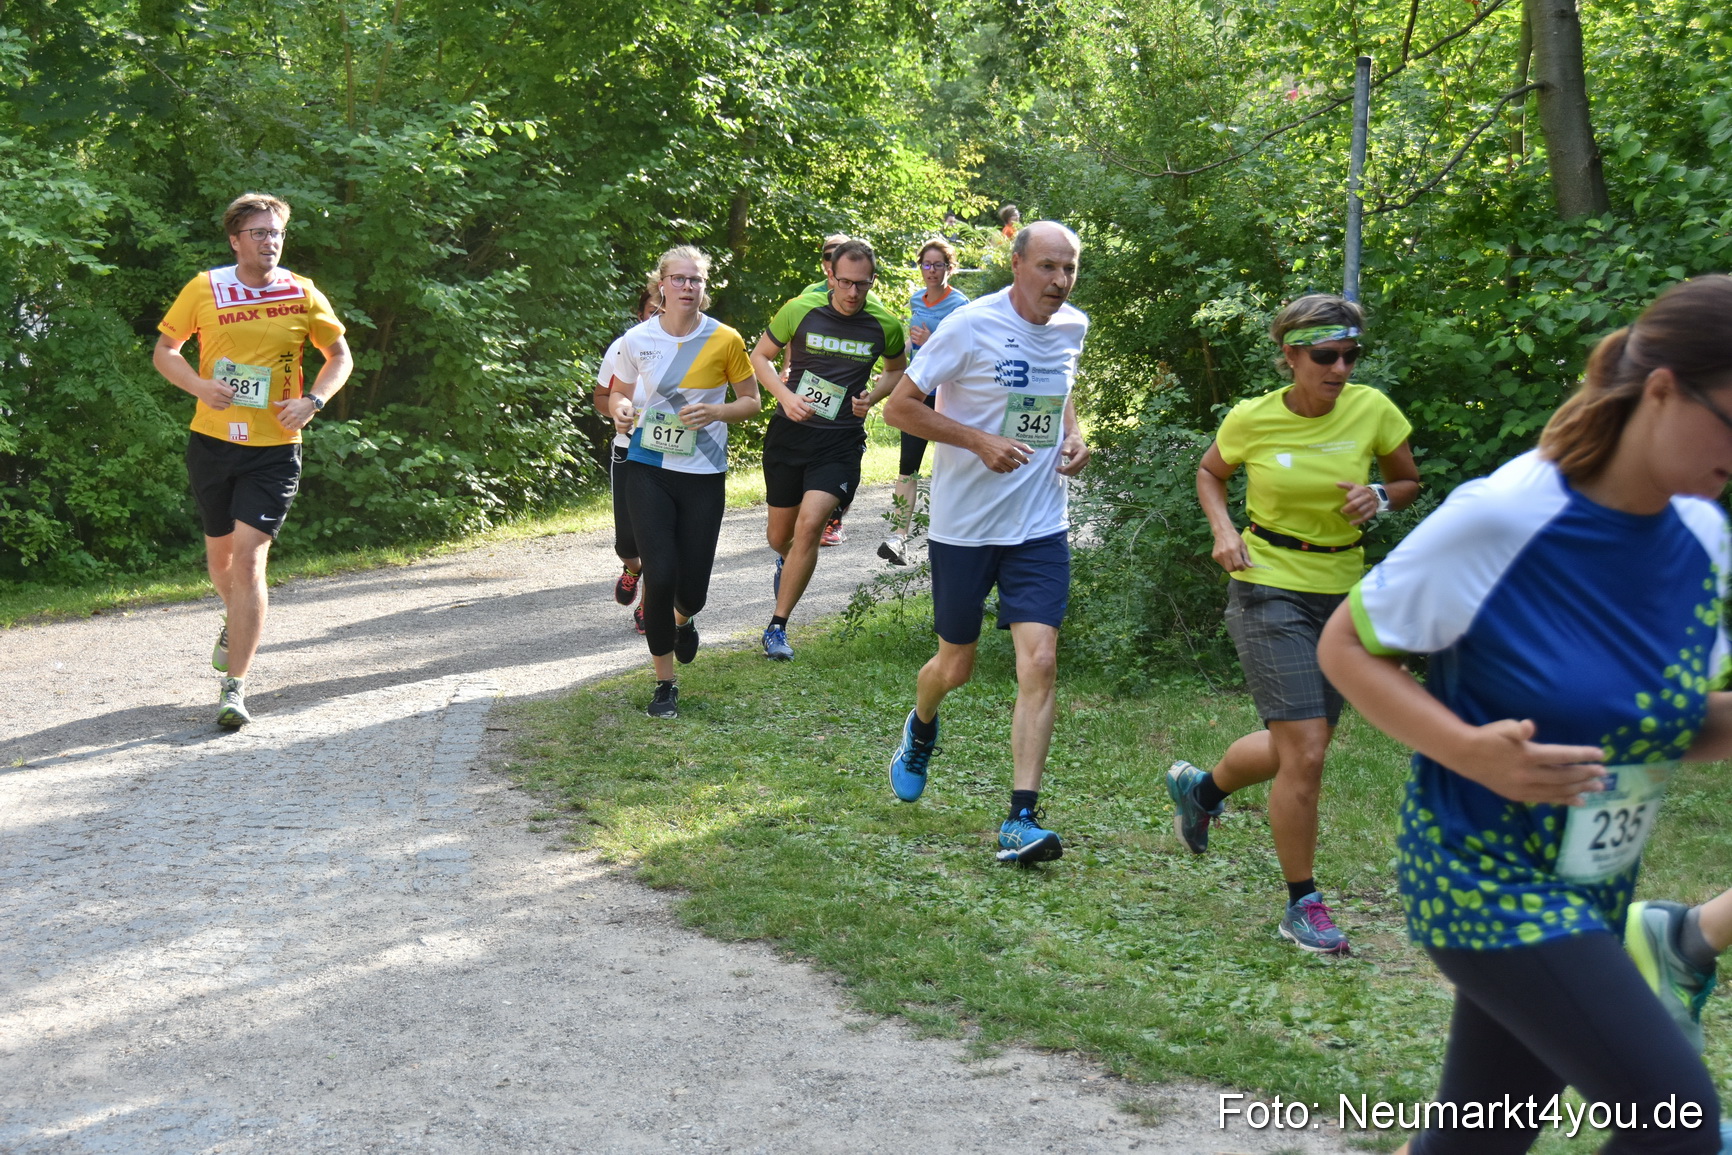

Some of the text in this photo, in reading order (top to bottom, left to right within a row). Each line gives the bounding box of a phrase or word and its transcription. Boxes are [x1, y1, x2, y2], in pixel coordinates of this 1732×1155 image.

[218, 303, 308, 326] MAX BÖGL
[807, 334, 872, 356] BOCK
[222, 376, 260, 397] 681
[1032, 376, 1050, 384] Bayern
[805, 387, 831, 408] 294
[1017, 414, 1051, 433] 343
[653, 425, 685, 444] 617
[1588, 803, 1647, 850] 235
